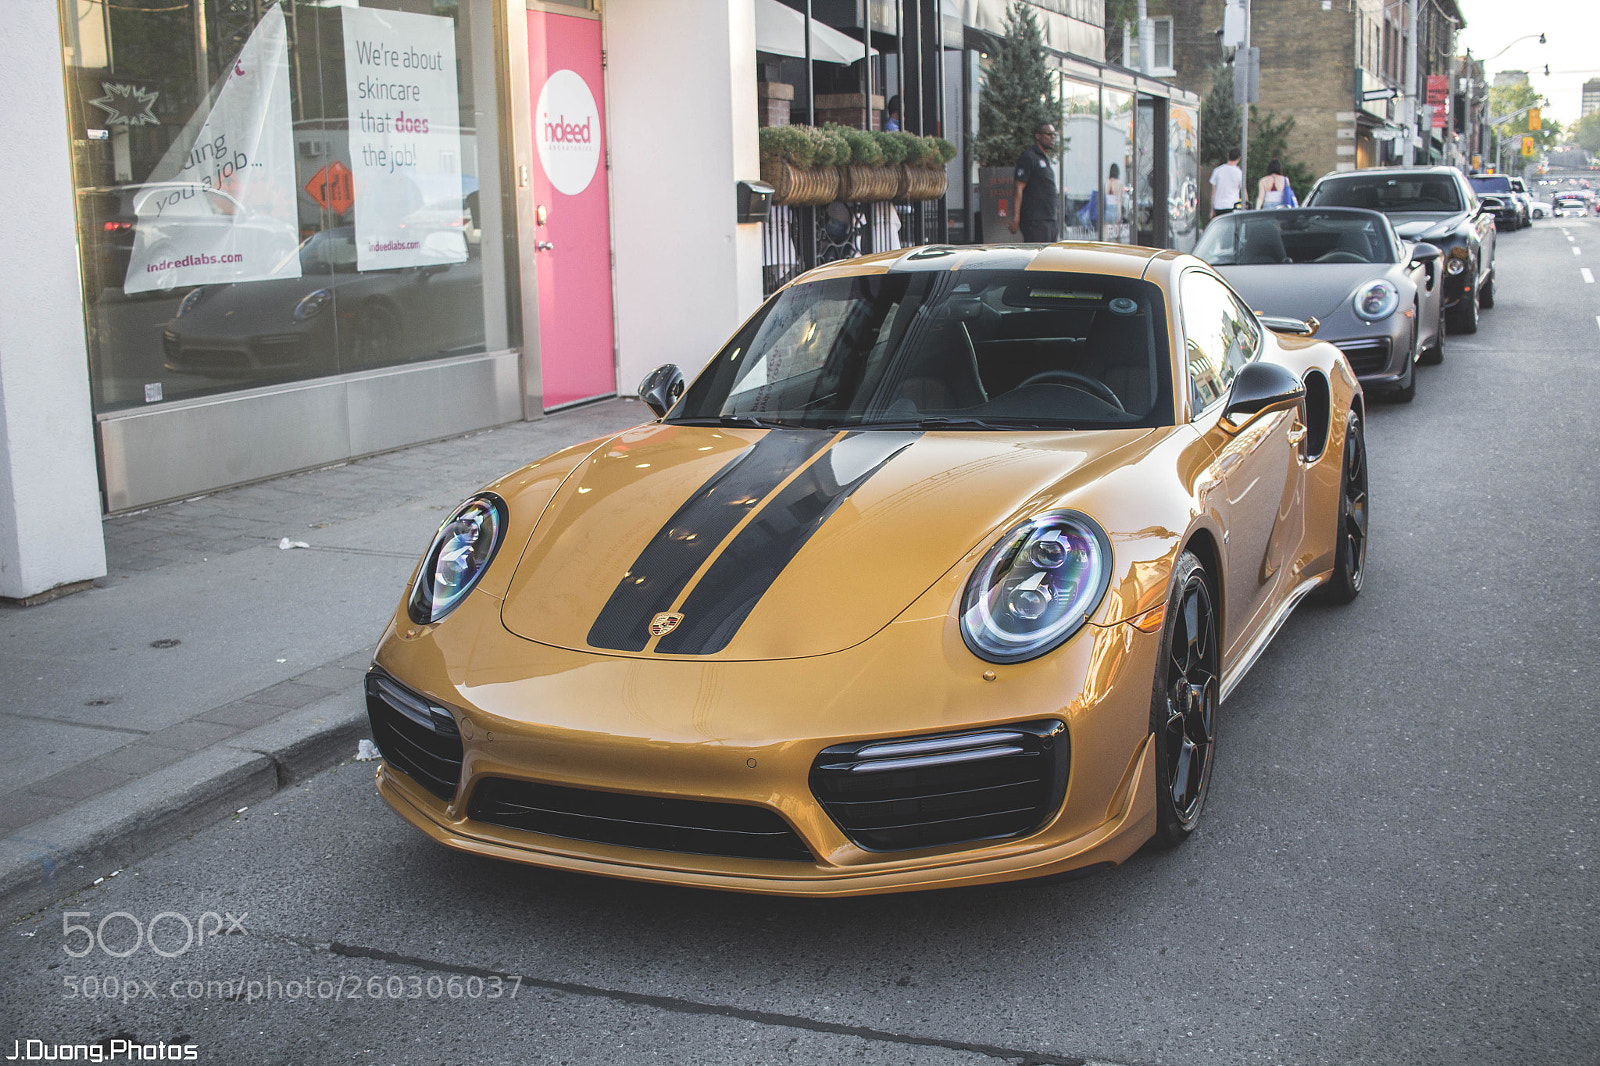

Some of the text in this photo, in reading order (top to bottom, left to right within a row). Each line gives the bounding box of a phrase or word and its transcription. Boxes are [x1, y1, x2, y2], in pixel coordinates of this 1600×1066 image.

[356, 40, 443, 71] We're about
[358, 75, 420, 102] skincare
[360, 109, 429, 134] that does
[544, 112, 591, 143] indeed
[362, 143, 417, 174] the job!
[156, 184, 195, 218] you
[202, 175, 212, 192] a
[369, 240, 420, 253] indeedlabs.com
